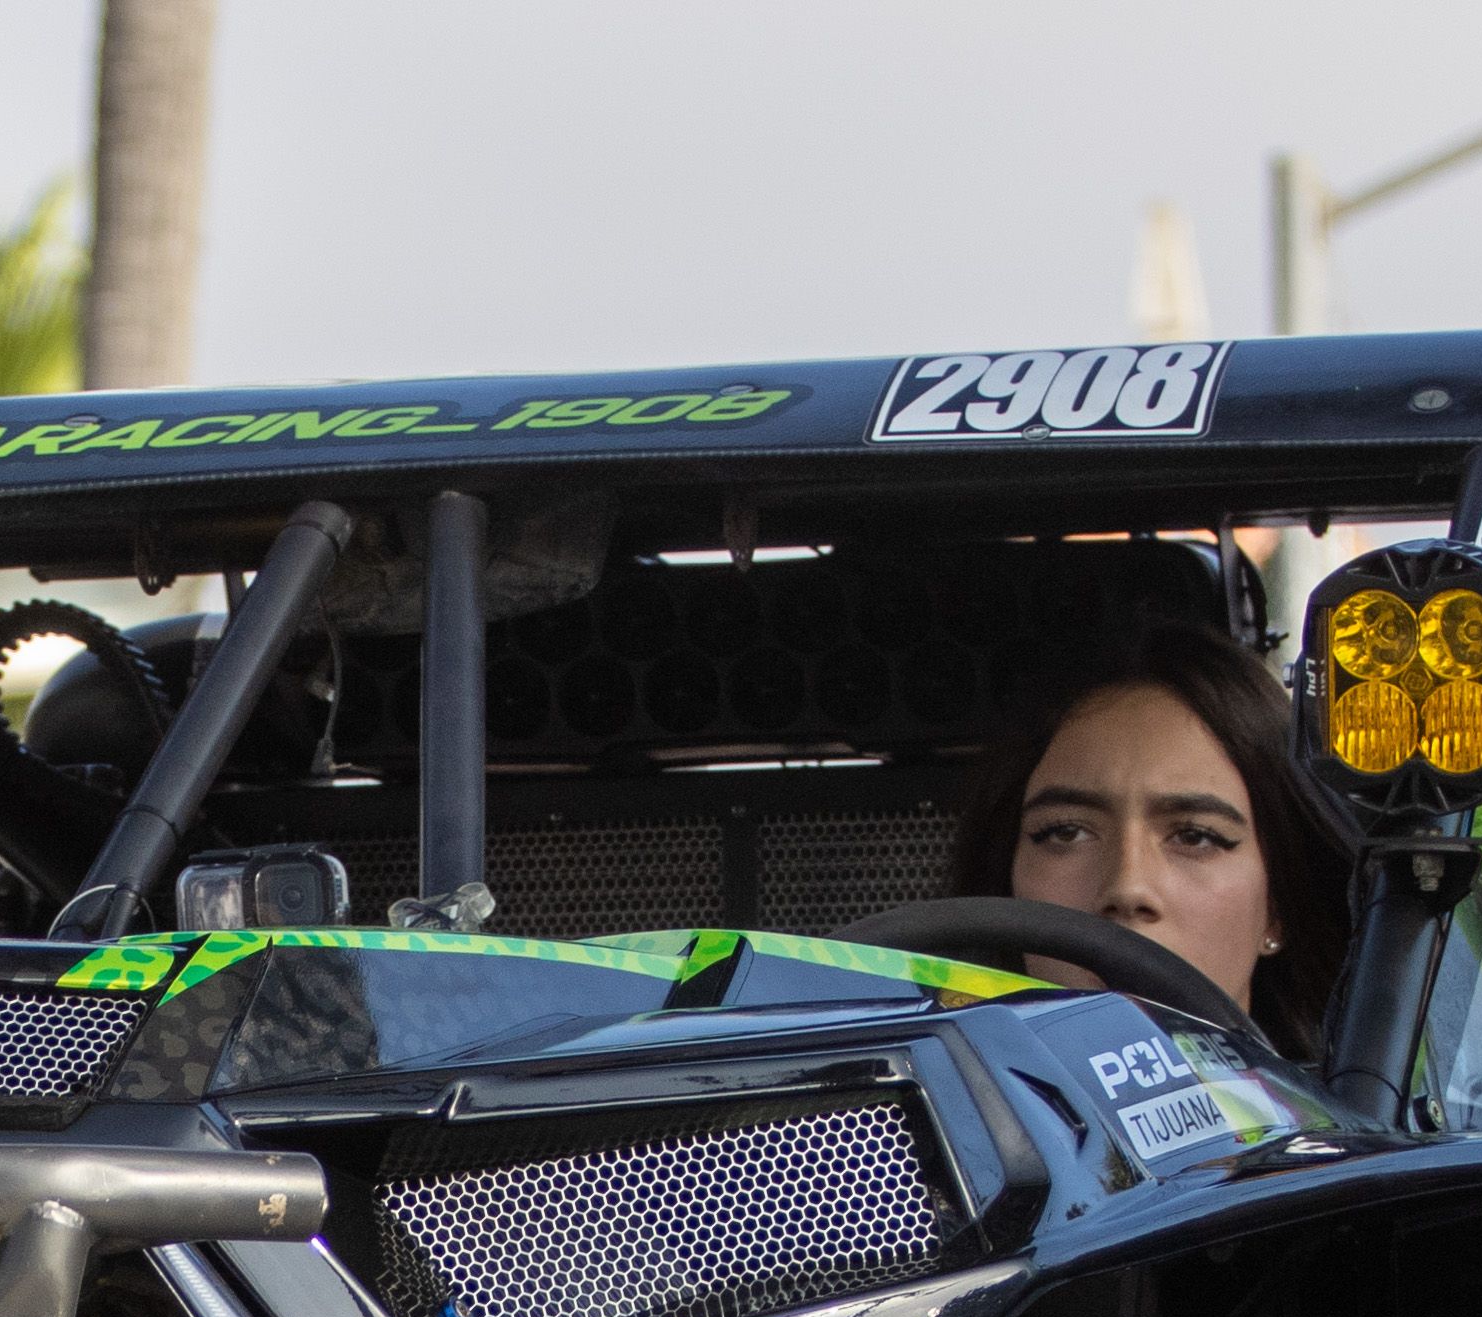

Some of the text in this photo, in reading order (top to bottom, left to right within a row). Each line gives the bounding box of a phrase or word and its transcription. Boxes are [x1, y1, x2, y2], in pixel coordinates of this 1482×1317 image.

[887, 342, 1211, 433] 2908
[1089, 1032, 1247, 1100] POLARIS
[1129, 1092, 1226, 1147] TIJUANA
